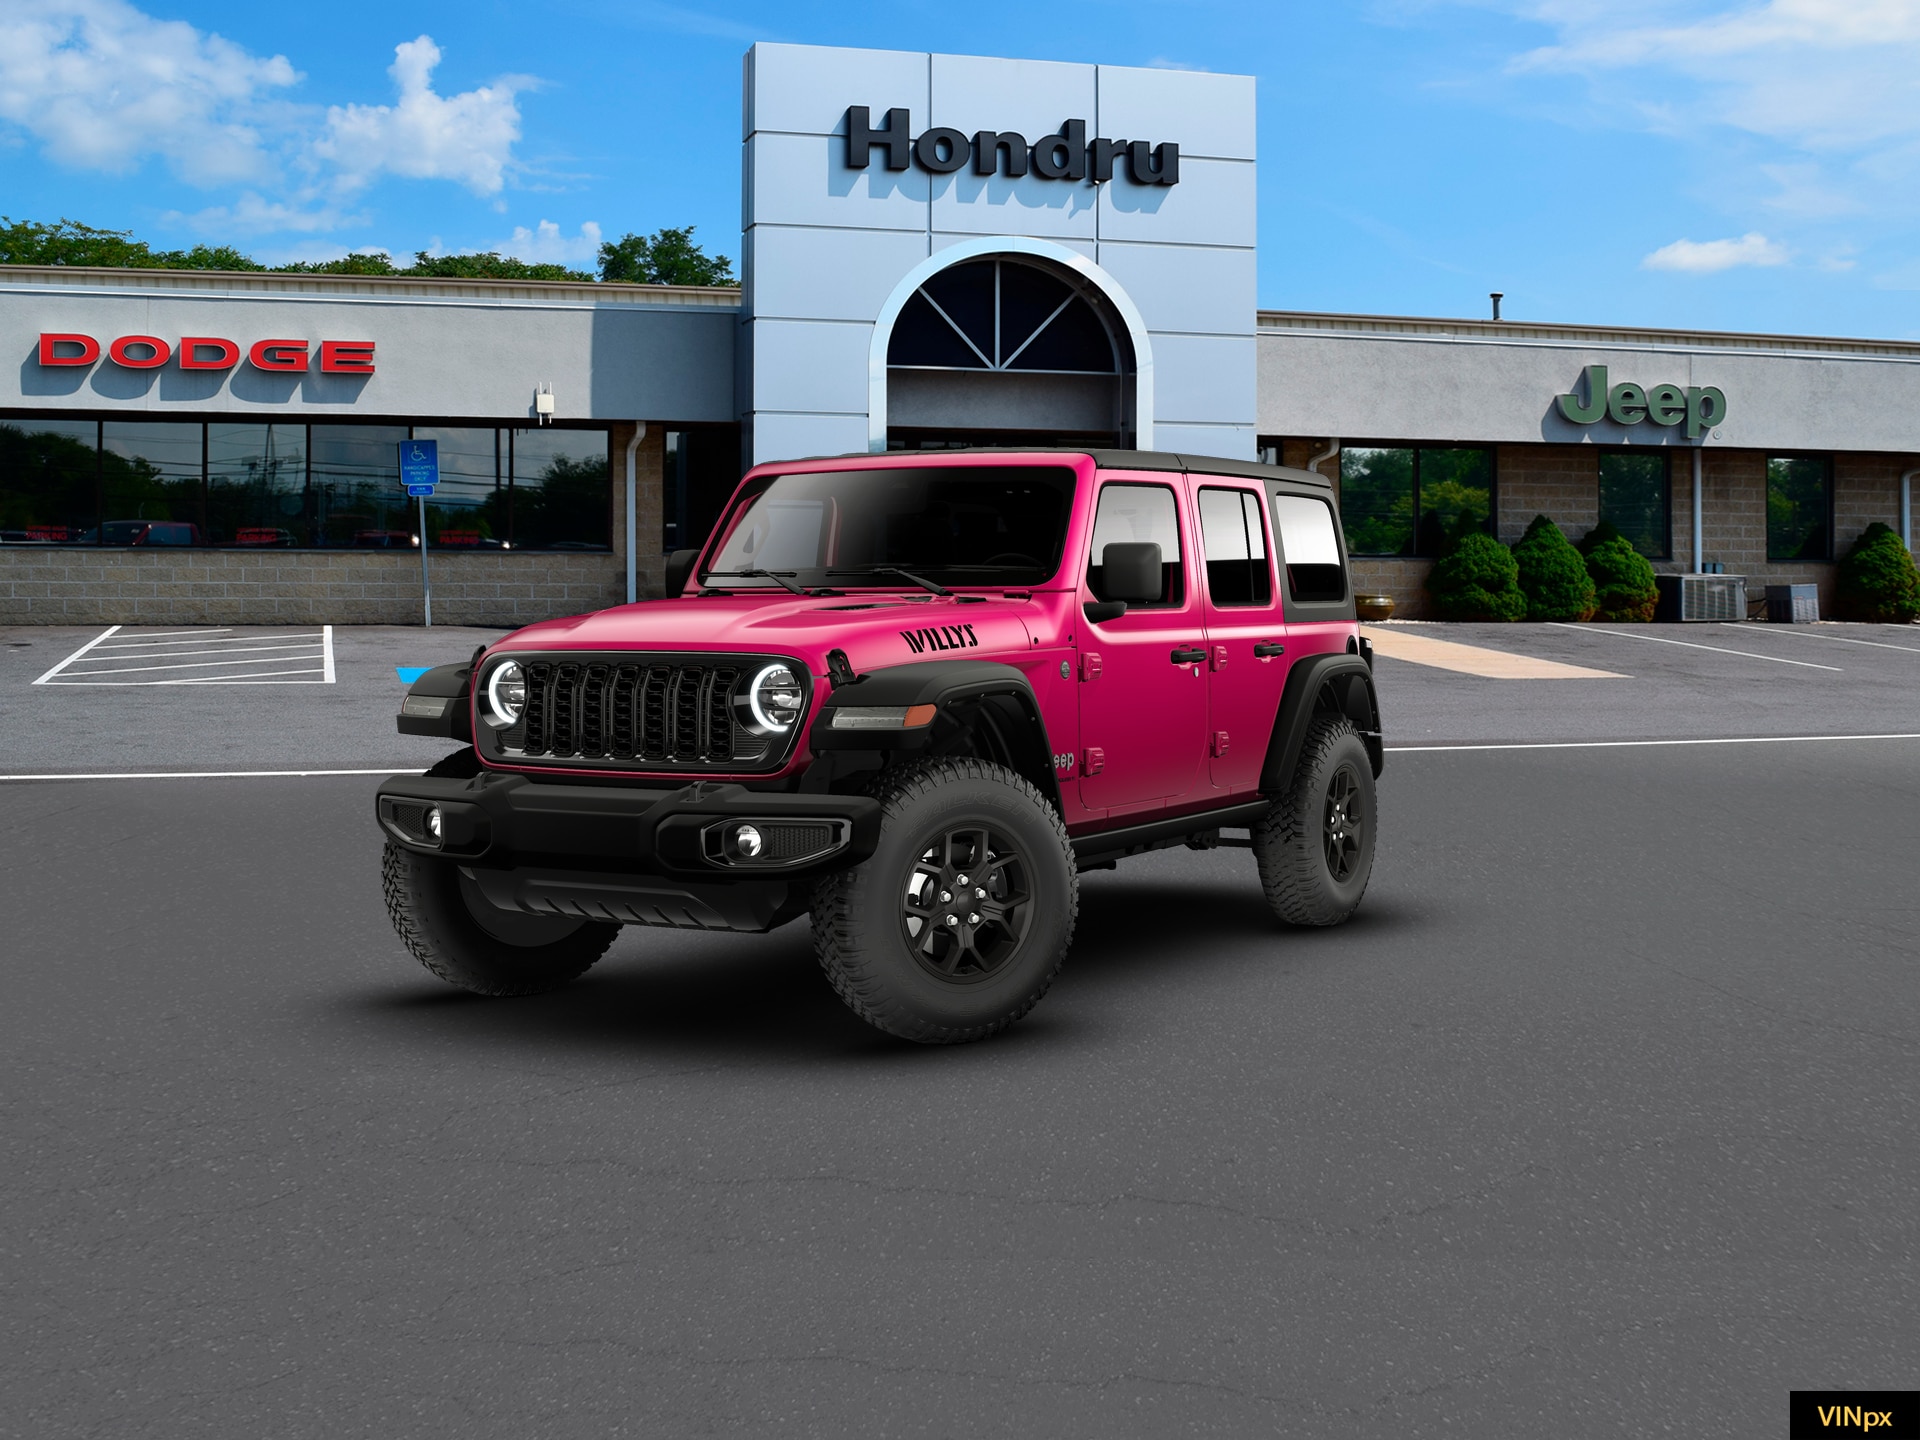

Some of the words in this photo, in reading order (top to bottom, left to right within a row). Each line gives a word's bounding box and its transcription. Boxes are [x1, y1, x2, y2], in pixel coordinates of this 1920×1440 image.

[846, 105, 1180, 186] Hondru
[38, 332, 376, 373] DODGE
[1556, 365, 1727, 440] Jeep
[26, 531, 68, 540] PARKING
[899, 623, 978, 654] WILLYS
[1053, 752, 1075, 771] eep
[906, 790, 1038, 838] FALKEN
